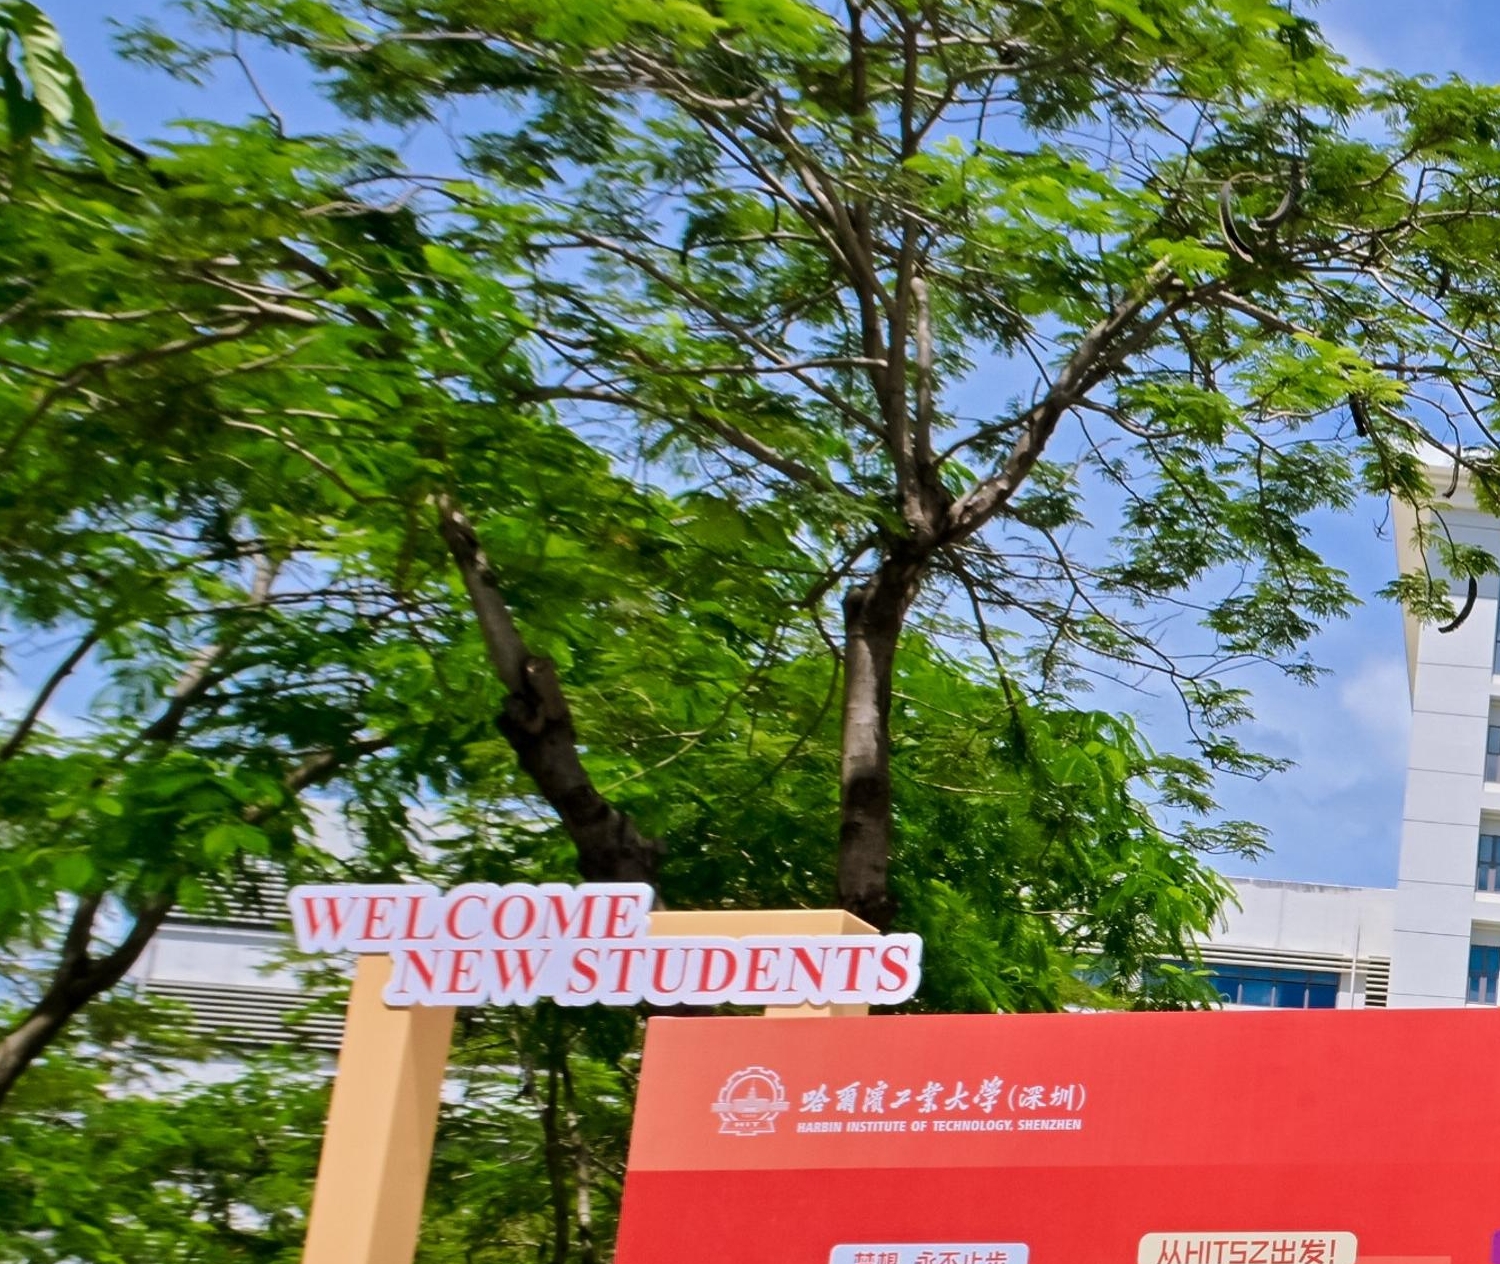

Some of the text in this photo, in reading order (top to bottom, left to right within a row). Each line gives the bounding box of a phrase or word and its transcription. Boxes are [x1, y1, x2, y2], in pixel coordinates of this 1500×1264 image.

[301, 892, 642, 941] WELCOME
[395, 945, 915, 997] NEW STUDENTS
[796, 1121, 842, 1133] HARBIN
[846, 1121, 906, 1132] INSTITUTE
[911, 1120, 927, 1132] OF
[1017, 1118, 1082, 1131] SHENZHEN
